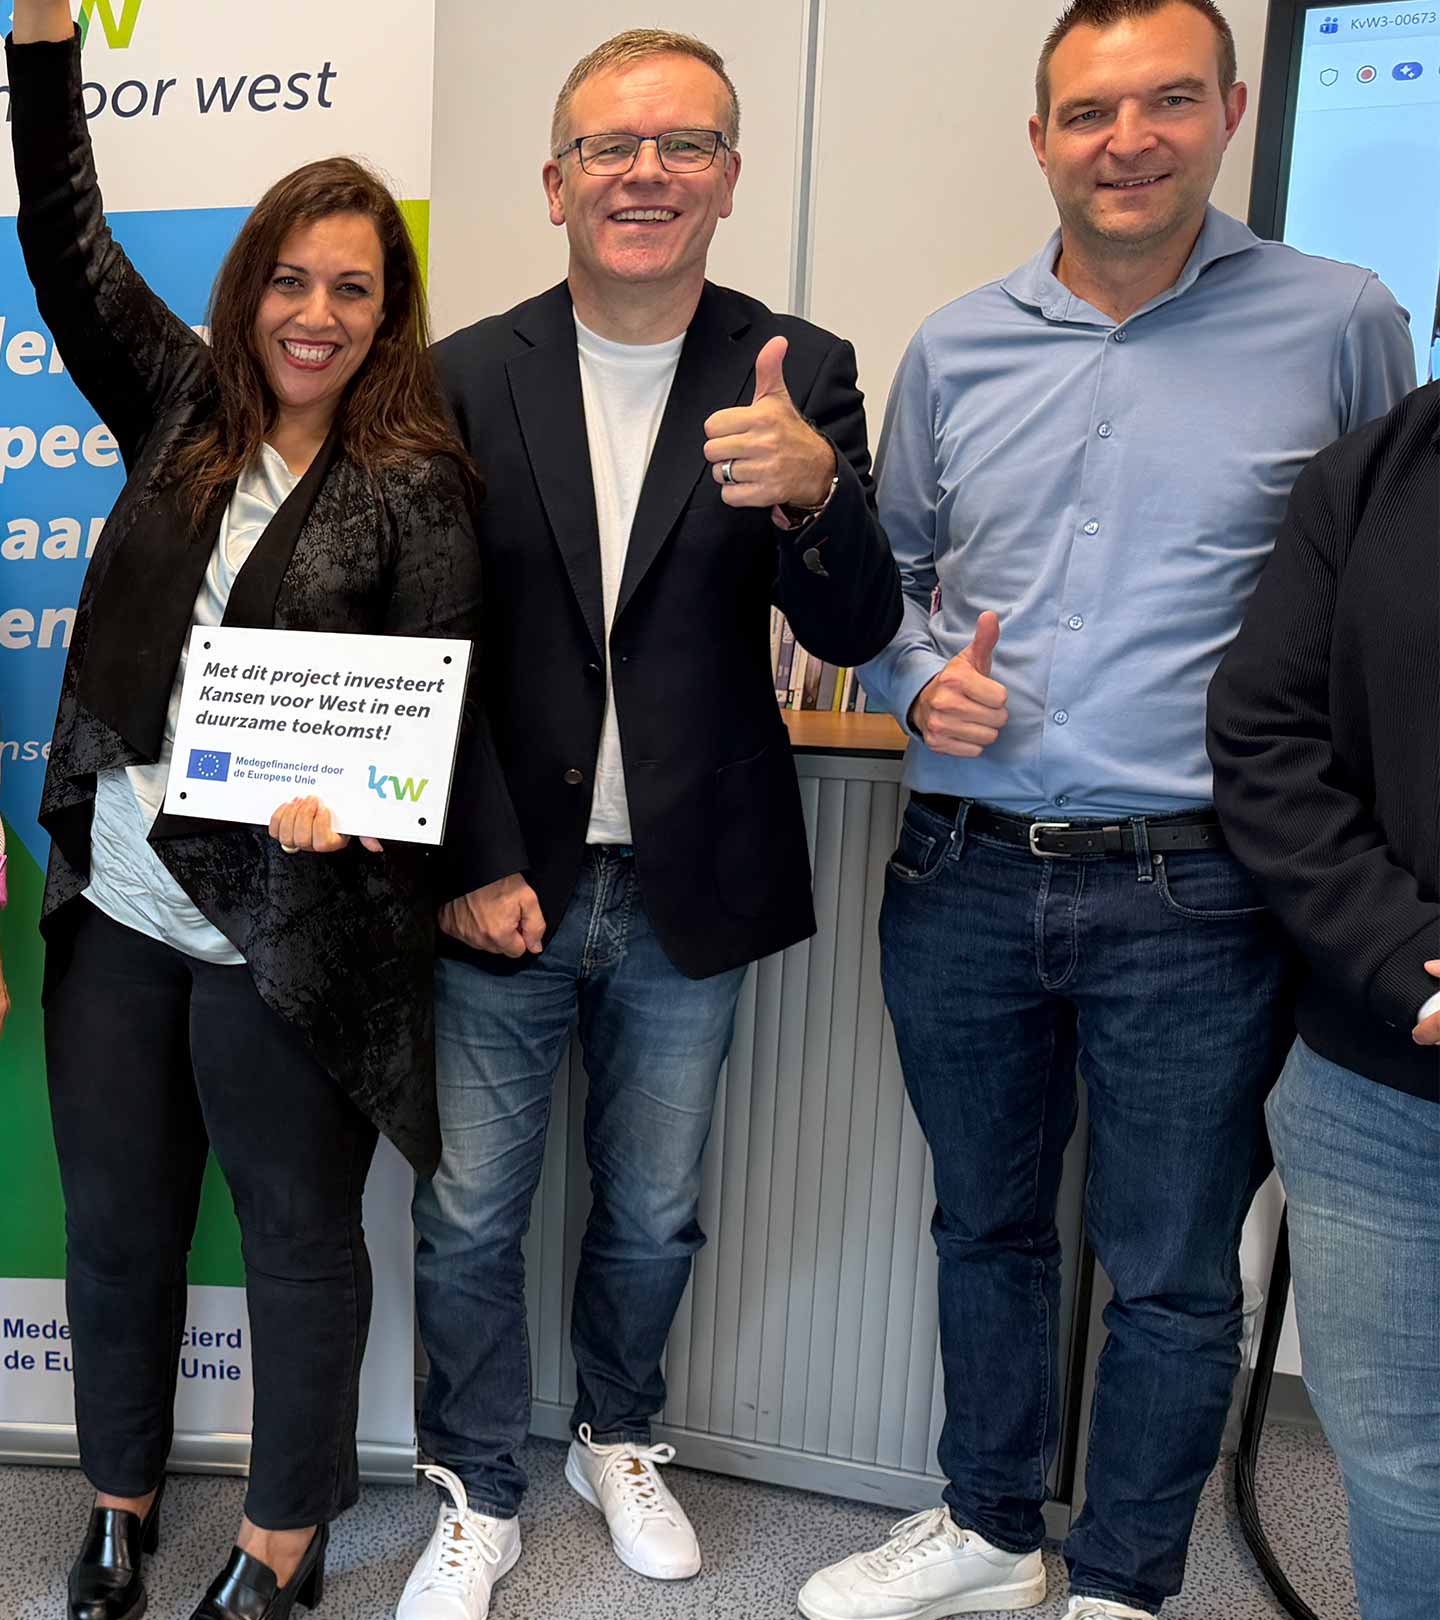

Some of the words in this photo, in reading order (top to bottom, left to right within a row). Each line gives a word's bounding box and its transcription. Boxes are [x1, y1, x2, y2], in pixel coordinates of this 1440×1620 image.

[1351, 11, 1437, 30] KvW3-00673
[81, 78, 177, 120] oor
[196, 62, 337, 114] west
[203, 662, 238, 679] Met
[242, 665, 268, 681] dit
[269, 669, 340, 688] project
[344, 671, 445, 693] investeert
[199, 686, 265, 705] Kansen
[271, 695, 314, 709] voor
[319, 694, 366, 713] West
[370, 698, 389, 715] in
[394, 704, 431, 718] een
[195, 710, 287, 732] duurzame
[292, 719, 391, 741] toekomst!
[233, 769, 245, 778] de
[247, 770, 292, 783] Europese
[294, 774, 316, 785] Unie
[235, 756, 319, 773] Medegefinancierd
[321, 764, 344, 775] door
[4, 1350, 35, 1370] de
[181, 1358, 241, 1381] Unie
